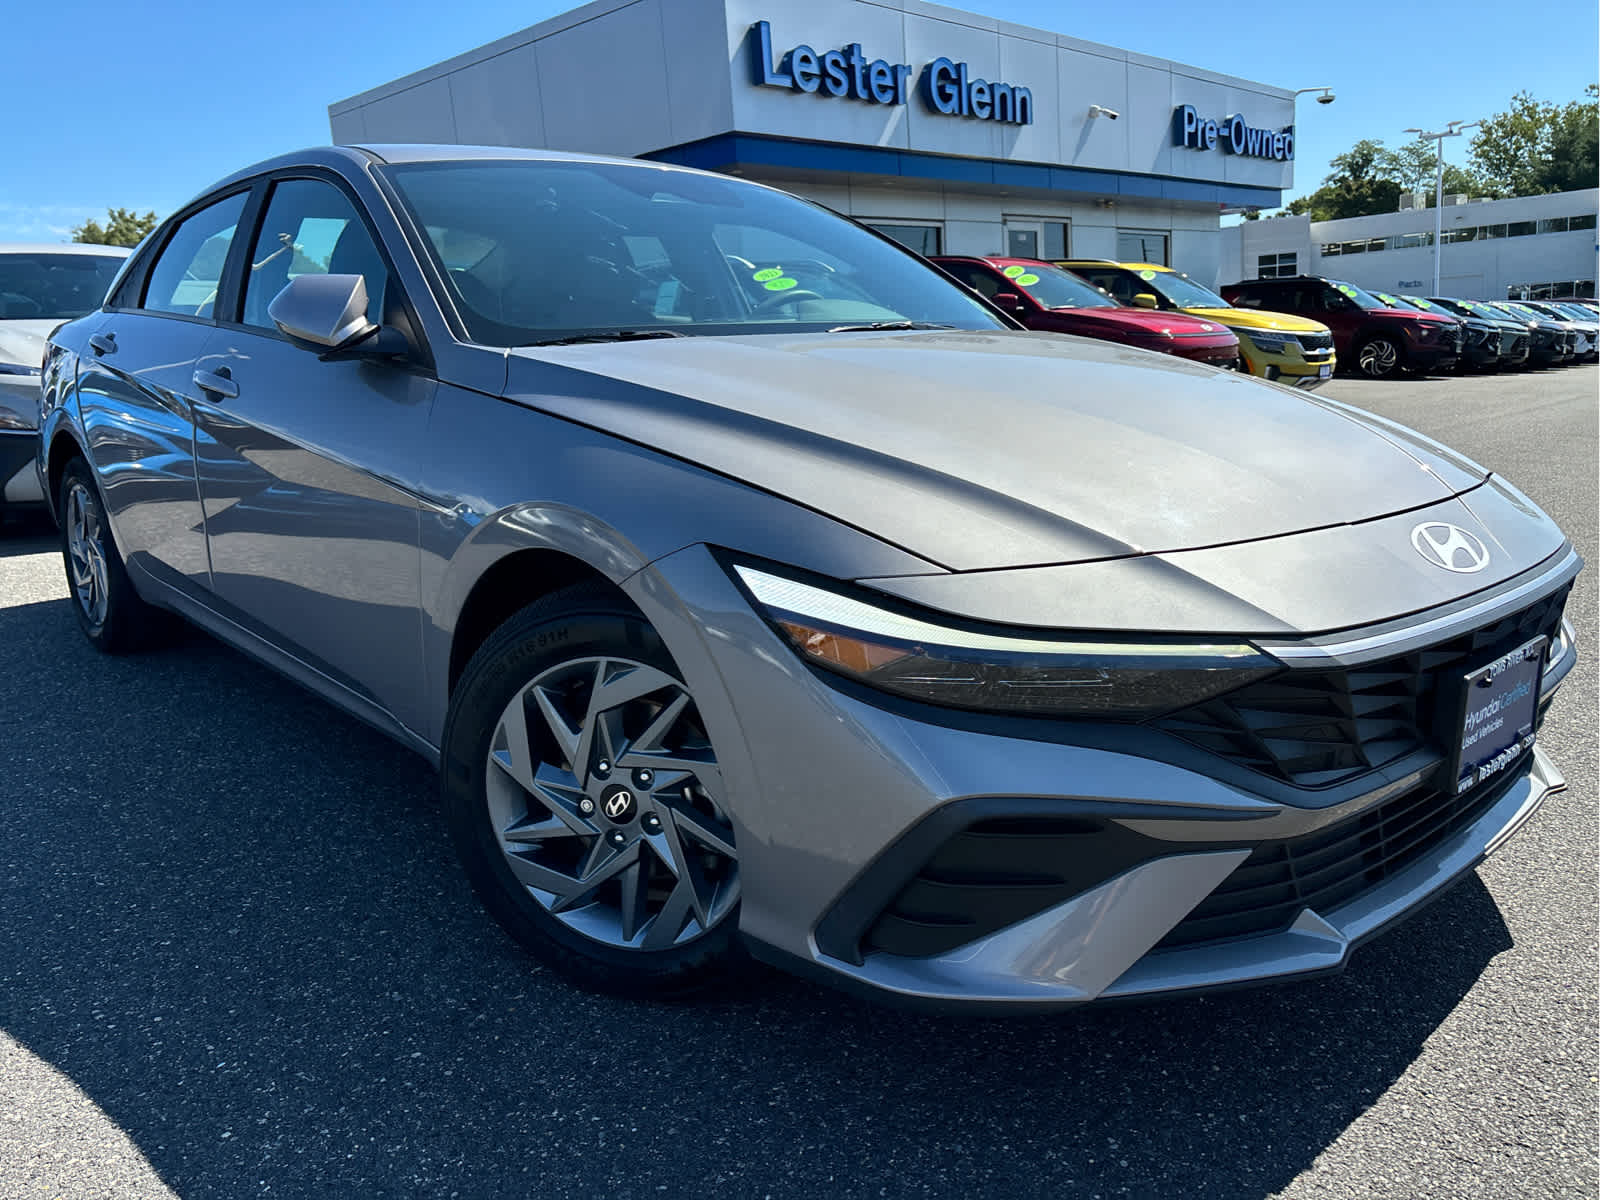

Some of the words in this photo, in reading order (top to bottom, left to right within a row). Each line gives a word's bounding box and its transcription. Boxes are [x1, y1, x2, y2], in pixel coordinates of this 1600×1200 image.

[751, 20, 912, 105] Lester
[923, 57, 1033, 125] Glenn
[1174, 104, 1295, 161] Pre-Owned
[1462, 732, 1479, 750] Used
[1479, 717, 1504, 738] Vehicles
[1464, 695, 1501, 731] Hyundai
